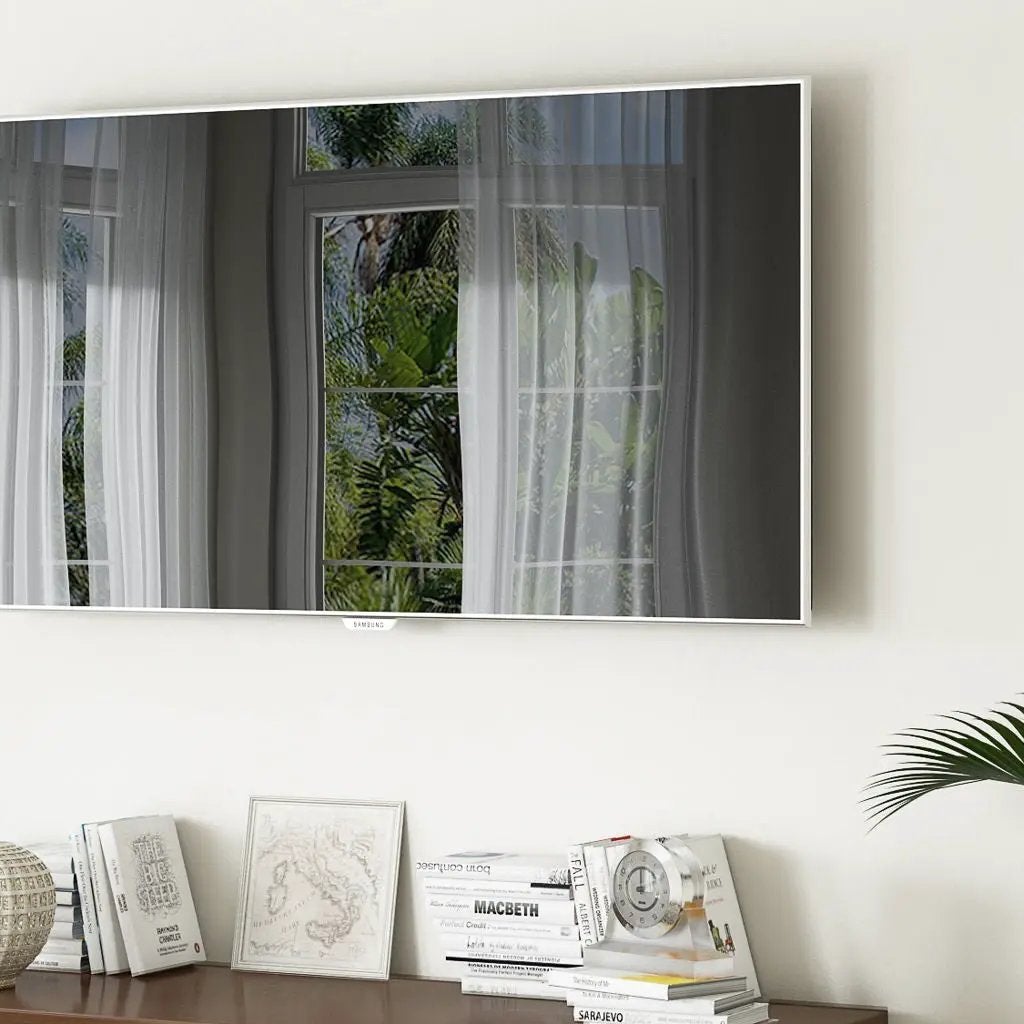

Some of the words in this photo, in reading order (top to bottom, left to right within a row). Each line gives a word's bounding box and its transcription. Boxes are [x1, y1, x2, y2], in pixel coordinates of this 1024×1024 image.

[571, 859, 585, 891] FALL
[474, 899, 539, 917] MACBETH
[466, 921, 487, 929] Credit
[578, 903, 592, 936] ALBERT
[578, 1010, 624, 1023] SARAJEVO
